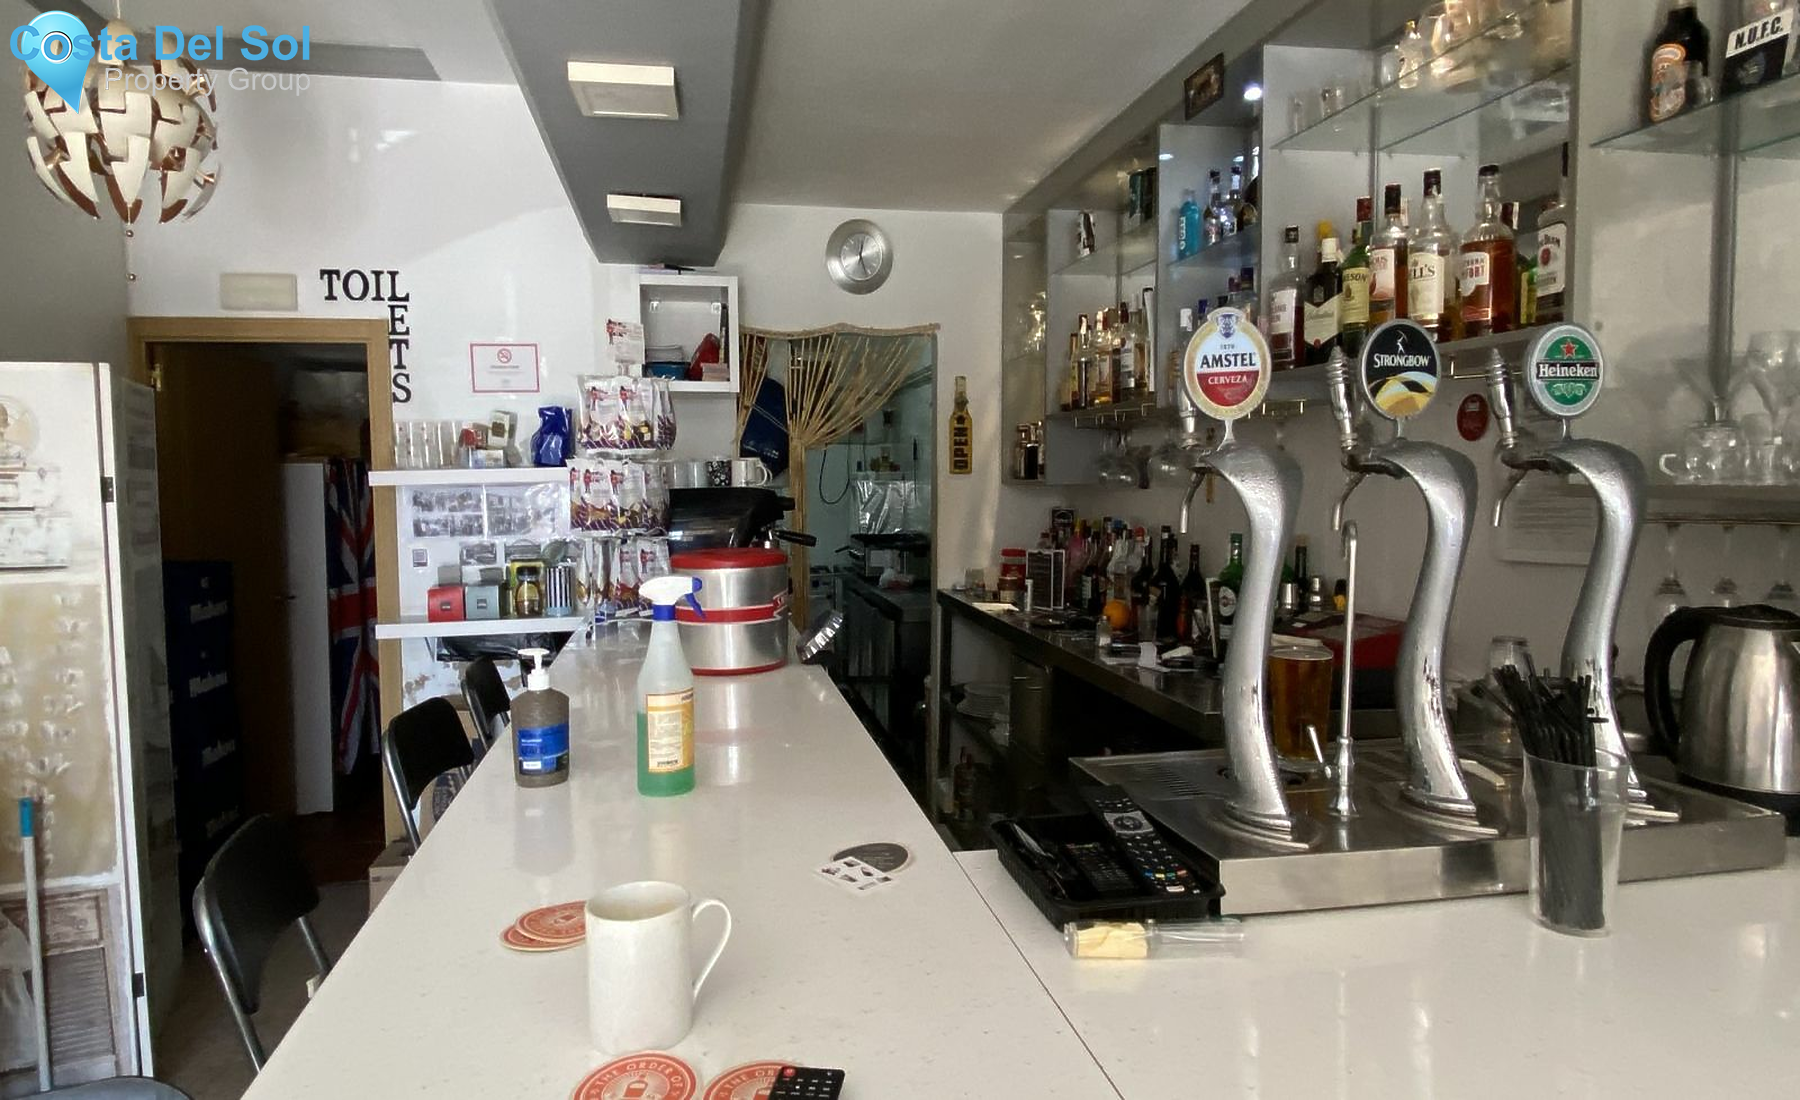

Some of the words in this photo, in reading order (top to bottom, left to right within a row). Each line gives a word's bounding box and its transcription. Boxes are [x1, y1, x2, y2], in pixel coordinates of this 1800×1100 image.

[1734, 16, 1784, 49] N.U.F.C.
[1200, 352, 1256, 369] AMSTEL
[1373, 353, 1429, 368] STRONGBOW
[1538, 363, 1597, 377] Heineken
[1208, 374, 1247, 385] CERVEZA
